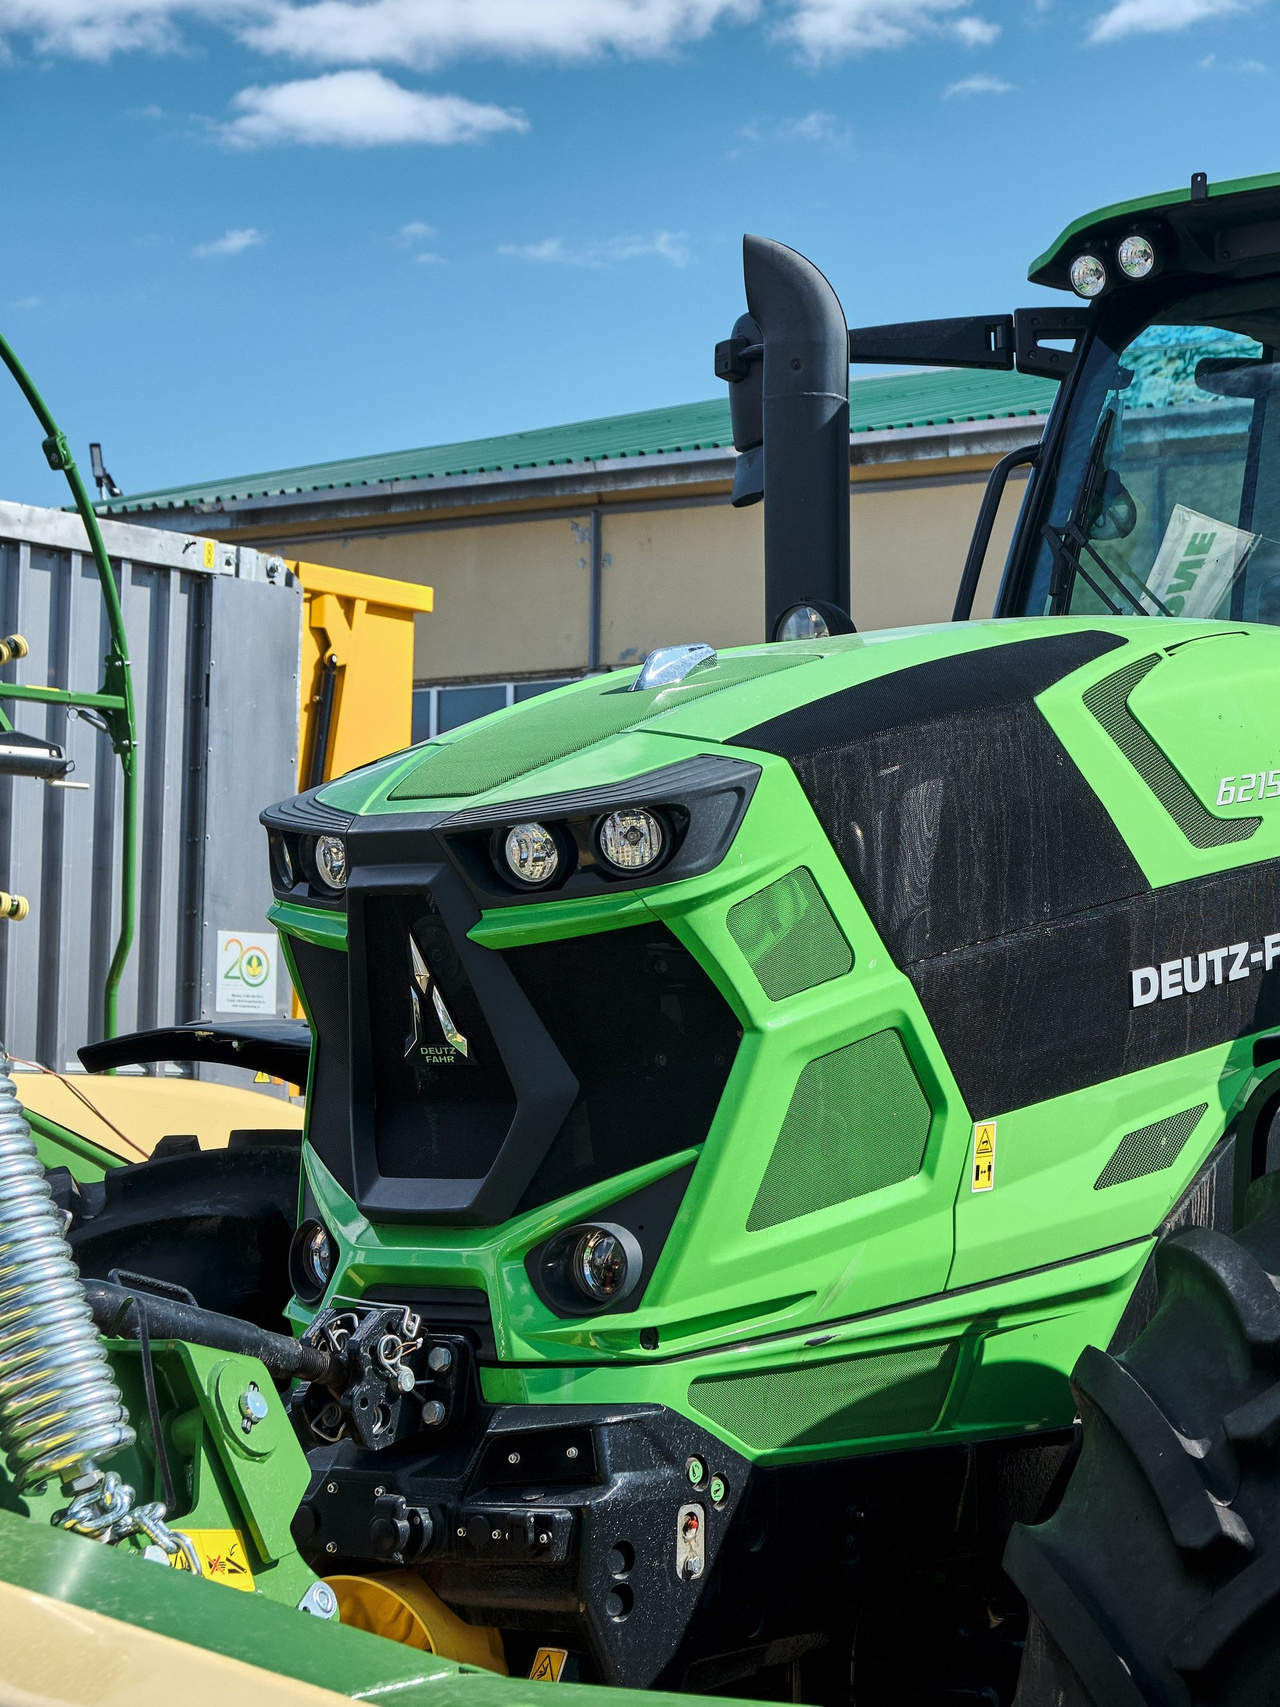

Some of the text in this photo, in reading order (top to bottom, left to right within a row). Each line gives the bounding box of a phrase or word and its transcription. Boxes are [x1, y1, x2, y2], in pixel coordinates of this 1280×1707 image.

[223, 937, 270, 989] 20
[420, 1047, 457, 1055] DEUTZ
[425, 1055, 455, 1063] FAHR
